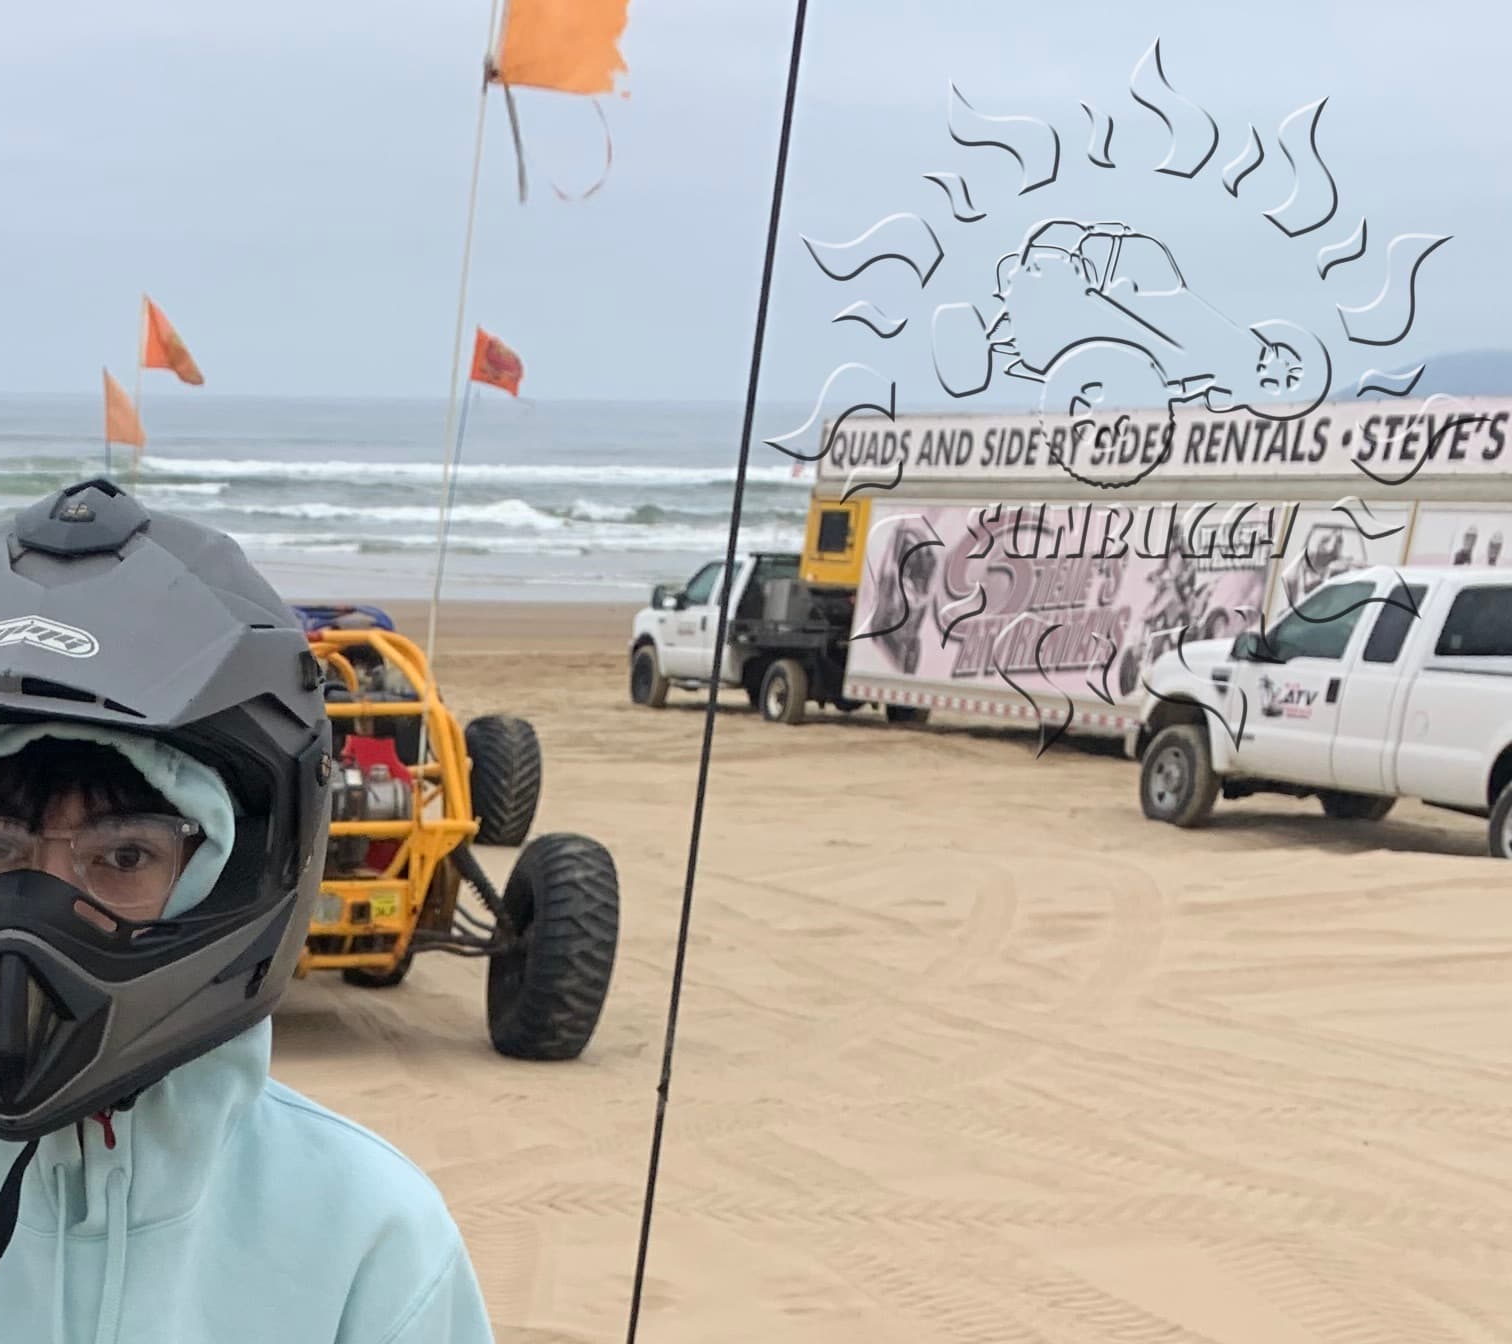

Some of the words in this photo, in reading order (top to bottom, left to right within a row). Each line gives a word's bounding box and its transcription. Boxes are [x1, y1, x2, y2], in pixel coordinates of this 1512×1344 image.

[830, 428, 912, 468] QUADS
[915, 428, 974, 467] AND
[980, 427, 1042, 467] SIDE
[1048, 426, 1086, 466] BY
[1090, 420, 1175, 467] SIDES
[1183, 416, 1332, 465] RENTALS
[1355, 411, 1510, 463] STEVE'S
